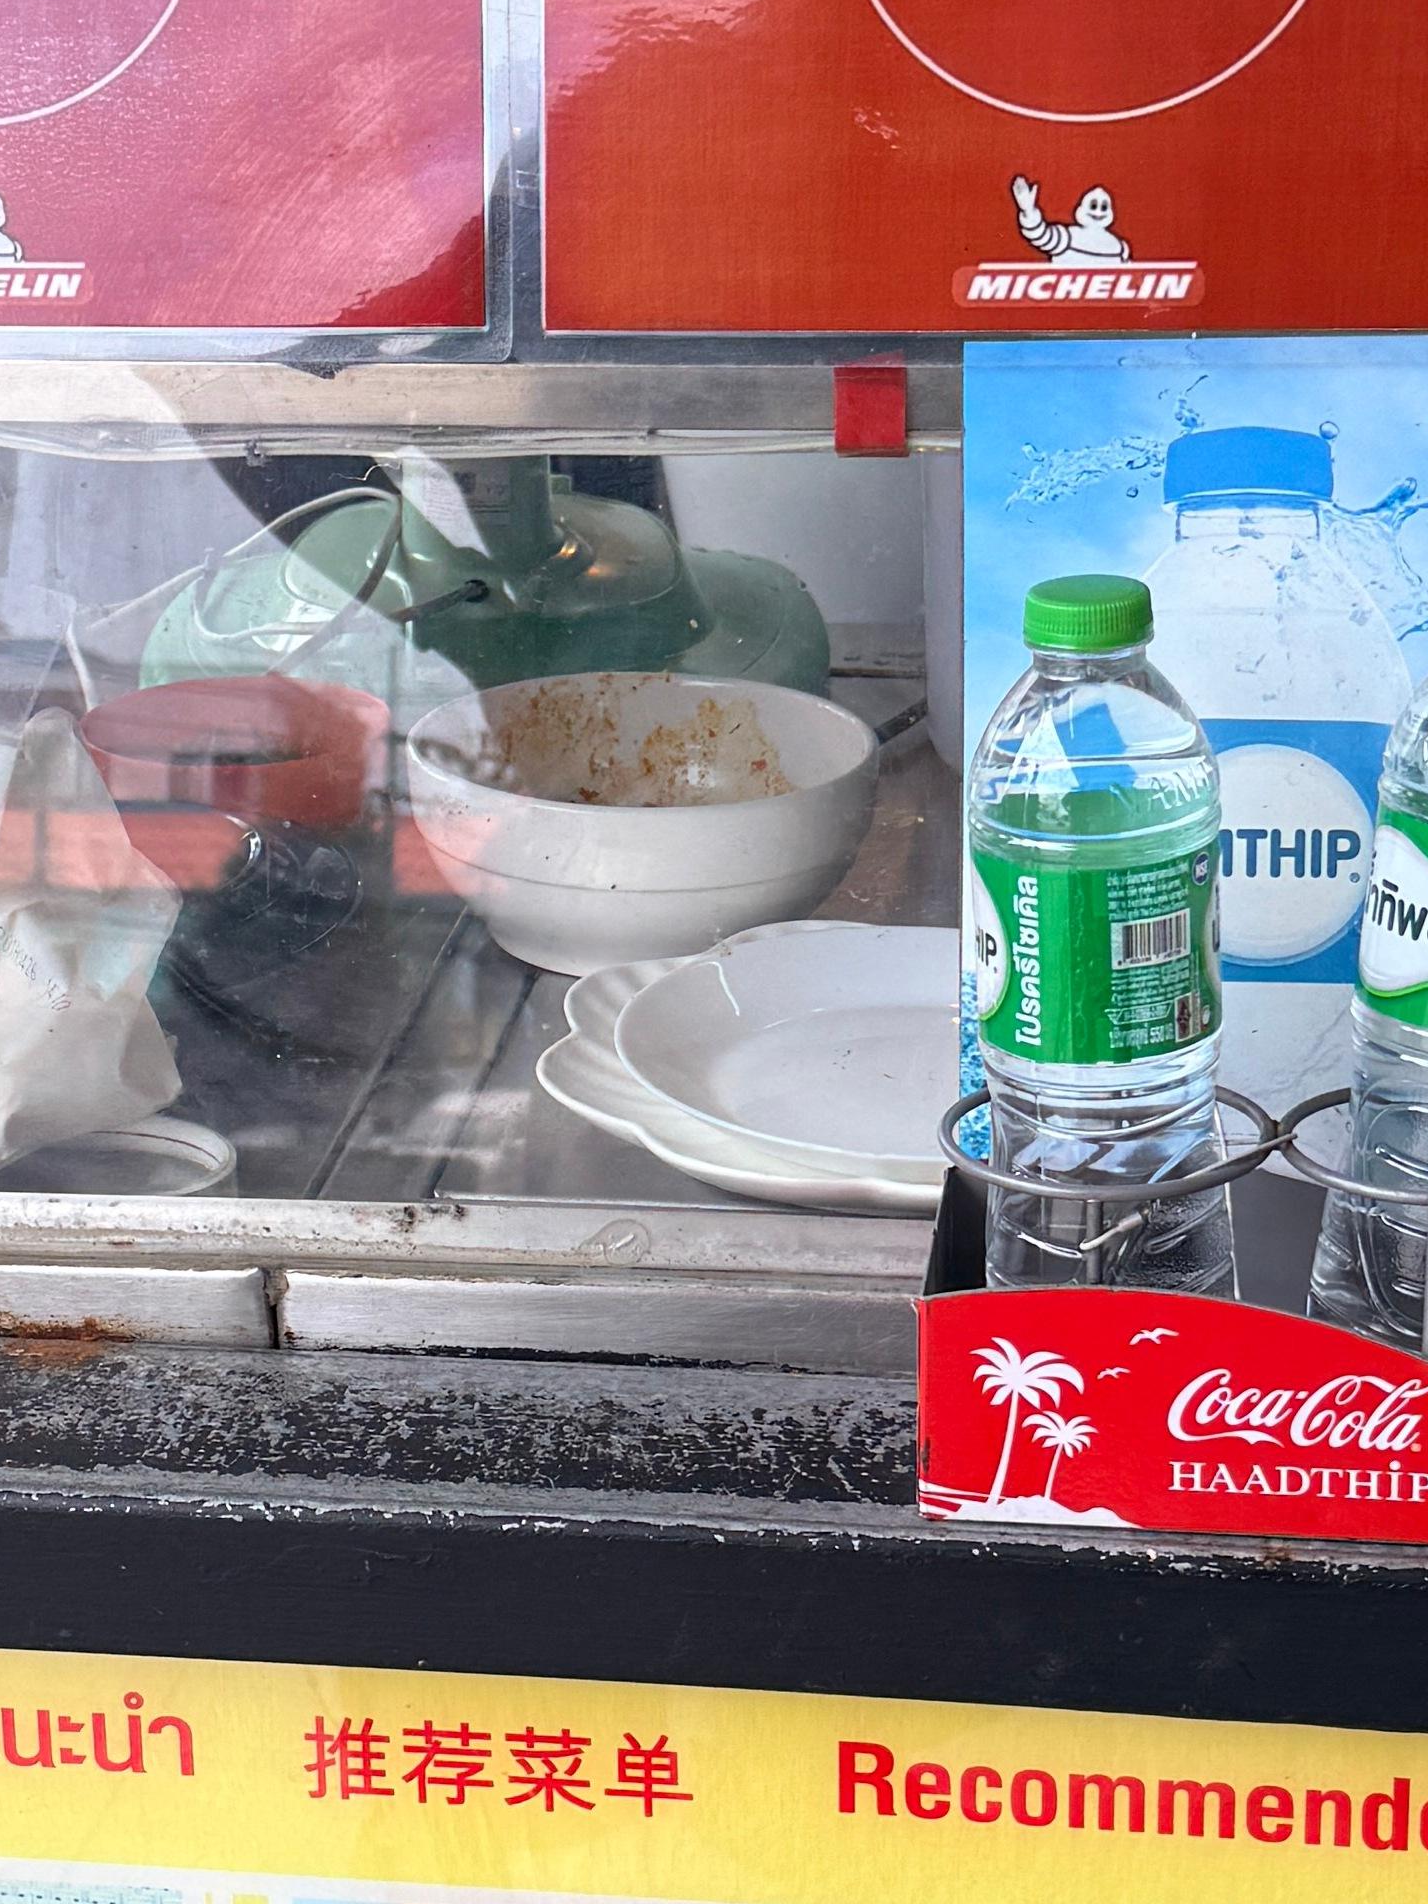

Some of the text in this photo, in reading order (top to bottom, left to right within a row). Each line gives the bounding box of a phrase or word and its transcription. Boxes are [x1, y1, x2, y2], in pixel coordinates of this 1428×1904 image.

[969, 275, 1190, 299] MICHELIN
[1014, 875, 1041, 1047] โปรดรีไซเคิล
[305, 1714, 696, 1822] 推荐菜单
